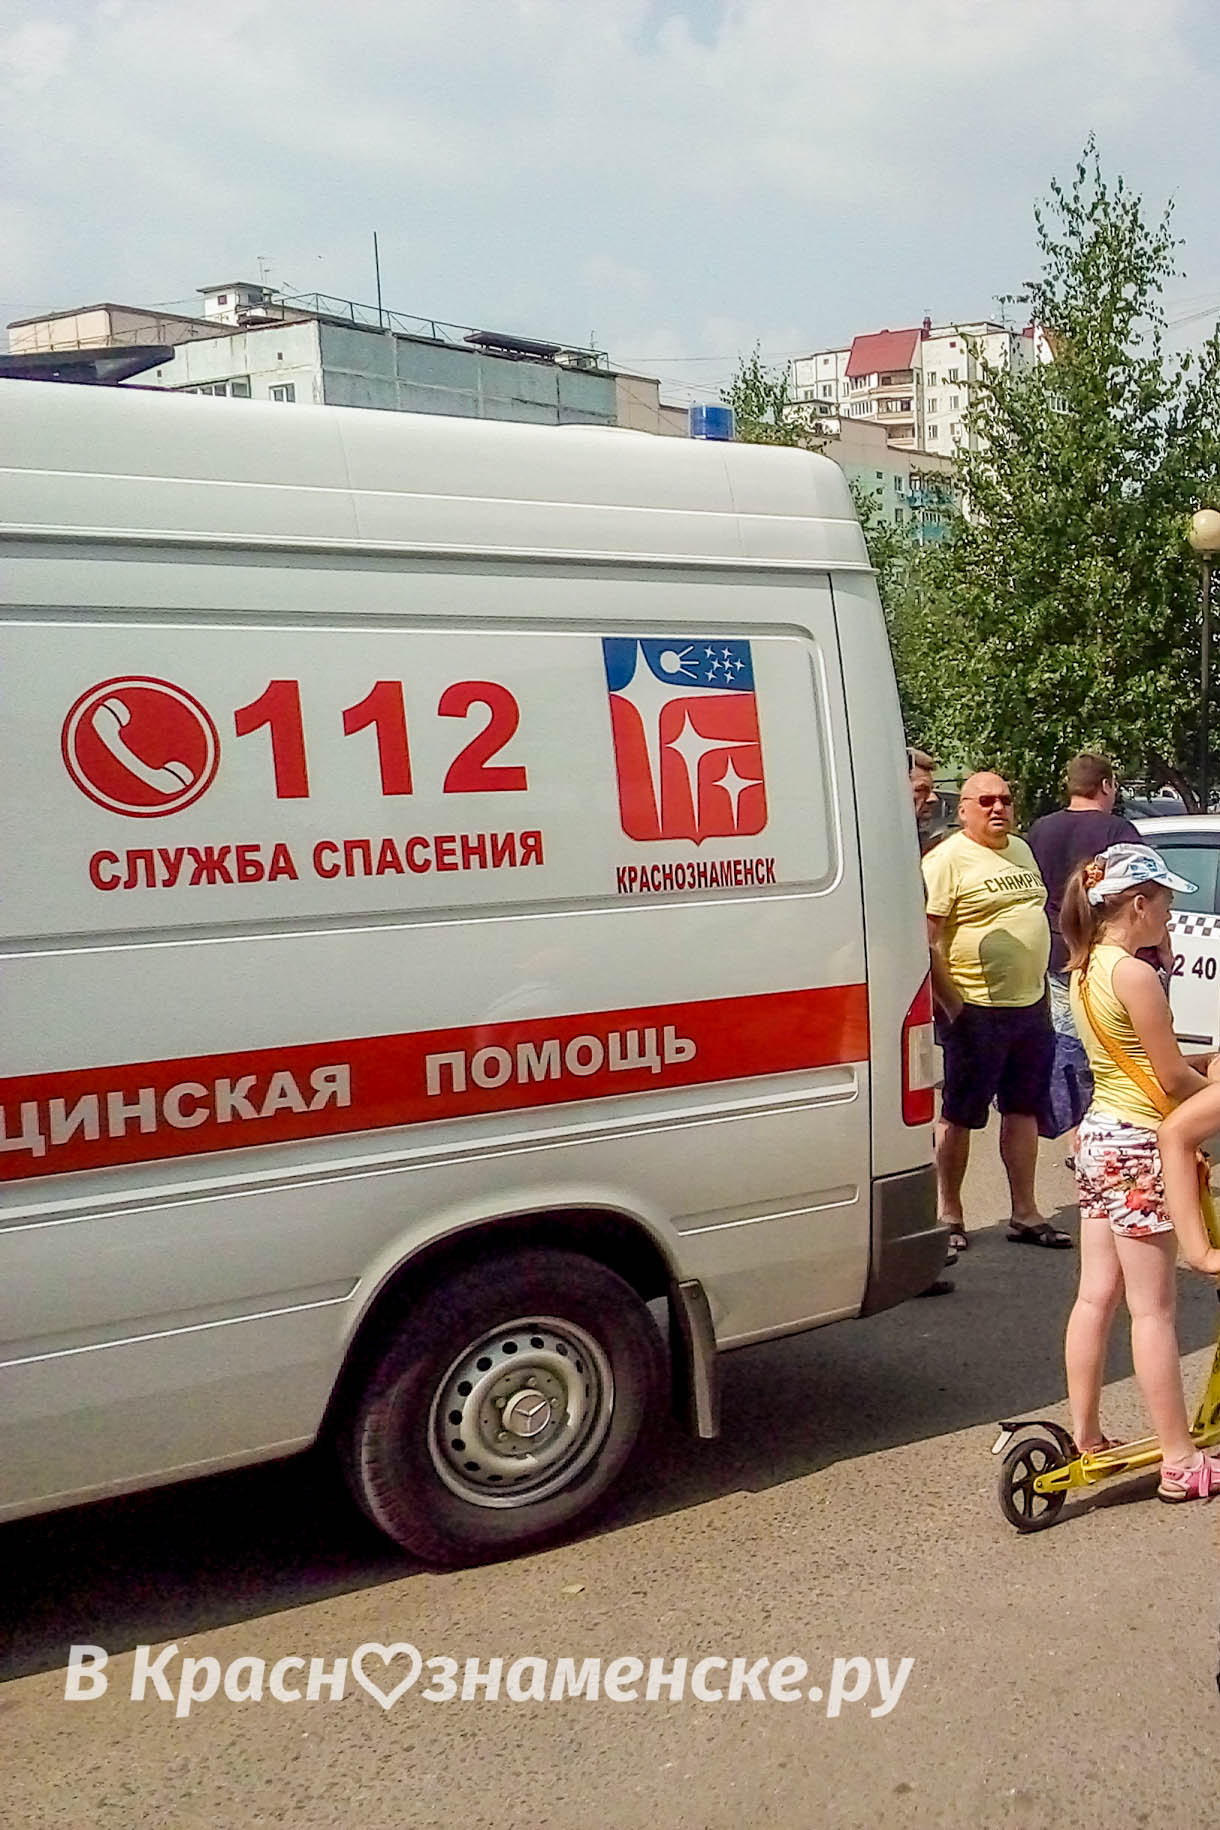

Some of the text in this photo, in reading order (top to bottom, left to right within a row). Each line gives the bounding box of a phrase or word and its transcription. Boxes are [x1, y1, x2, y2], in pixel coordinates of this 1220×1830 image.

[234, 679, 528, 799] 112
[89, 830, 545, 891] СЛУЖБА СПАСЕНИЯ
[616, 857, 777, 894] КРАСНОЗНАМЕНСК
[1191, 956, 1217, 980] 40
[0, 1025, 697, 1158] ЦИНСКАЯ ПОМОЩЬ
